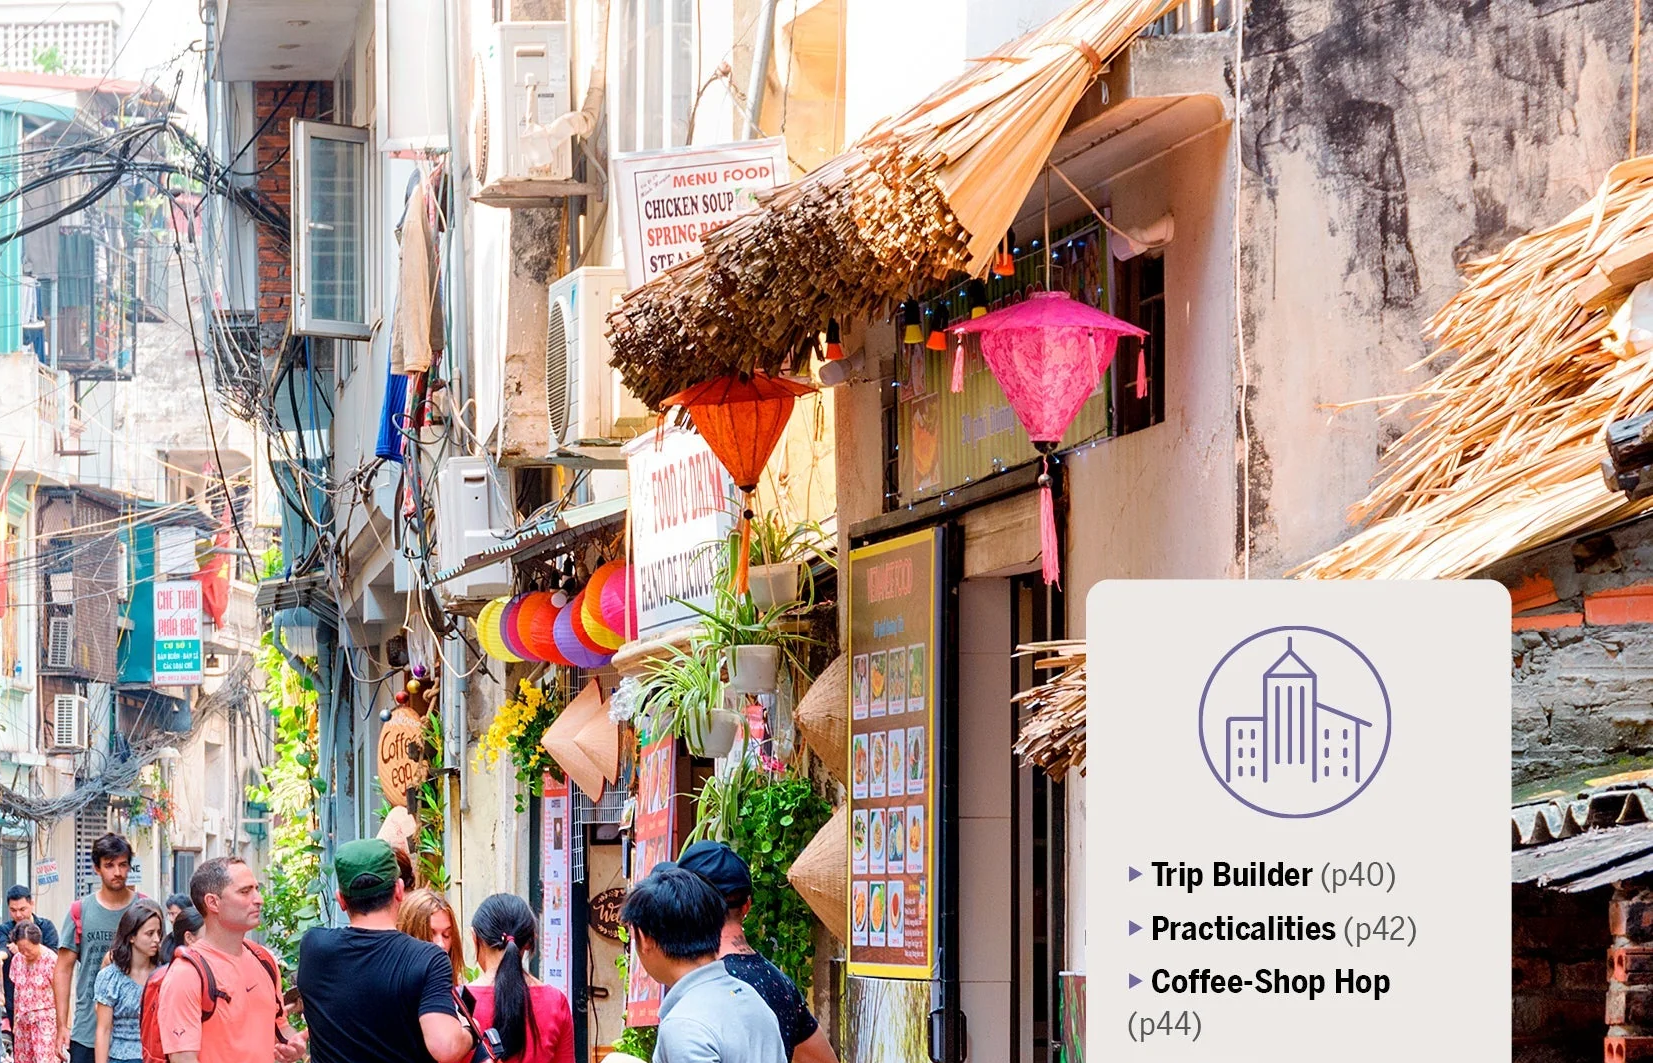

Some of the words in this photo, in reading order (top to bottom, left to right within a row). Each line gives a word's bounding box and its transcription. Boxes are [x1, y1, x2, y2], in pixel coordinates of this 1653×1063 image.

[673, 171, 718, 188] MENU
[723, 166, 770, 183] FOOD
[644, 196, 700, 220] CHICKEN
[702, 191, 734, 213] SOUP
[647, 224, 697, 247] SPRING
[651, 463, 679, 534] FOOD
